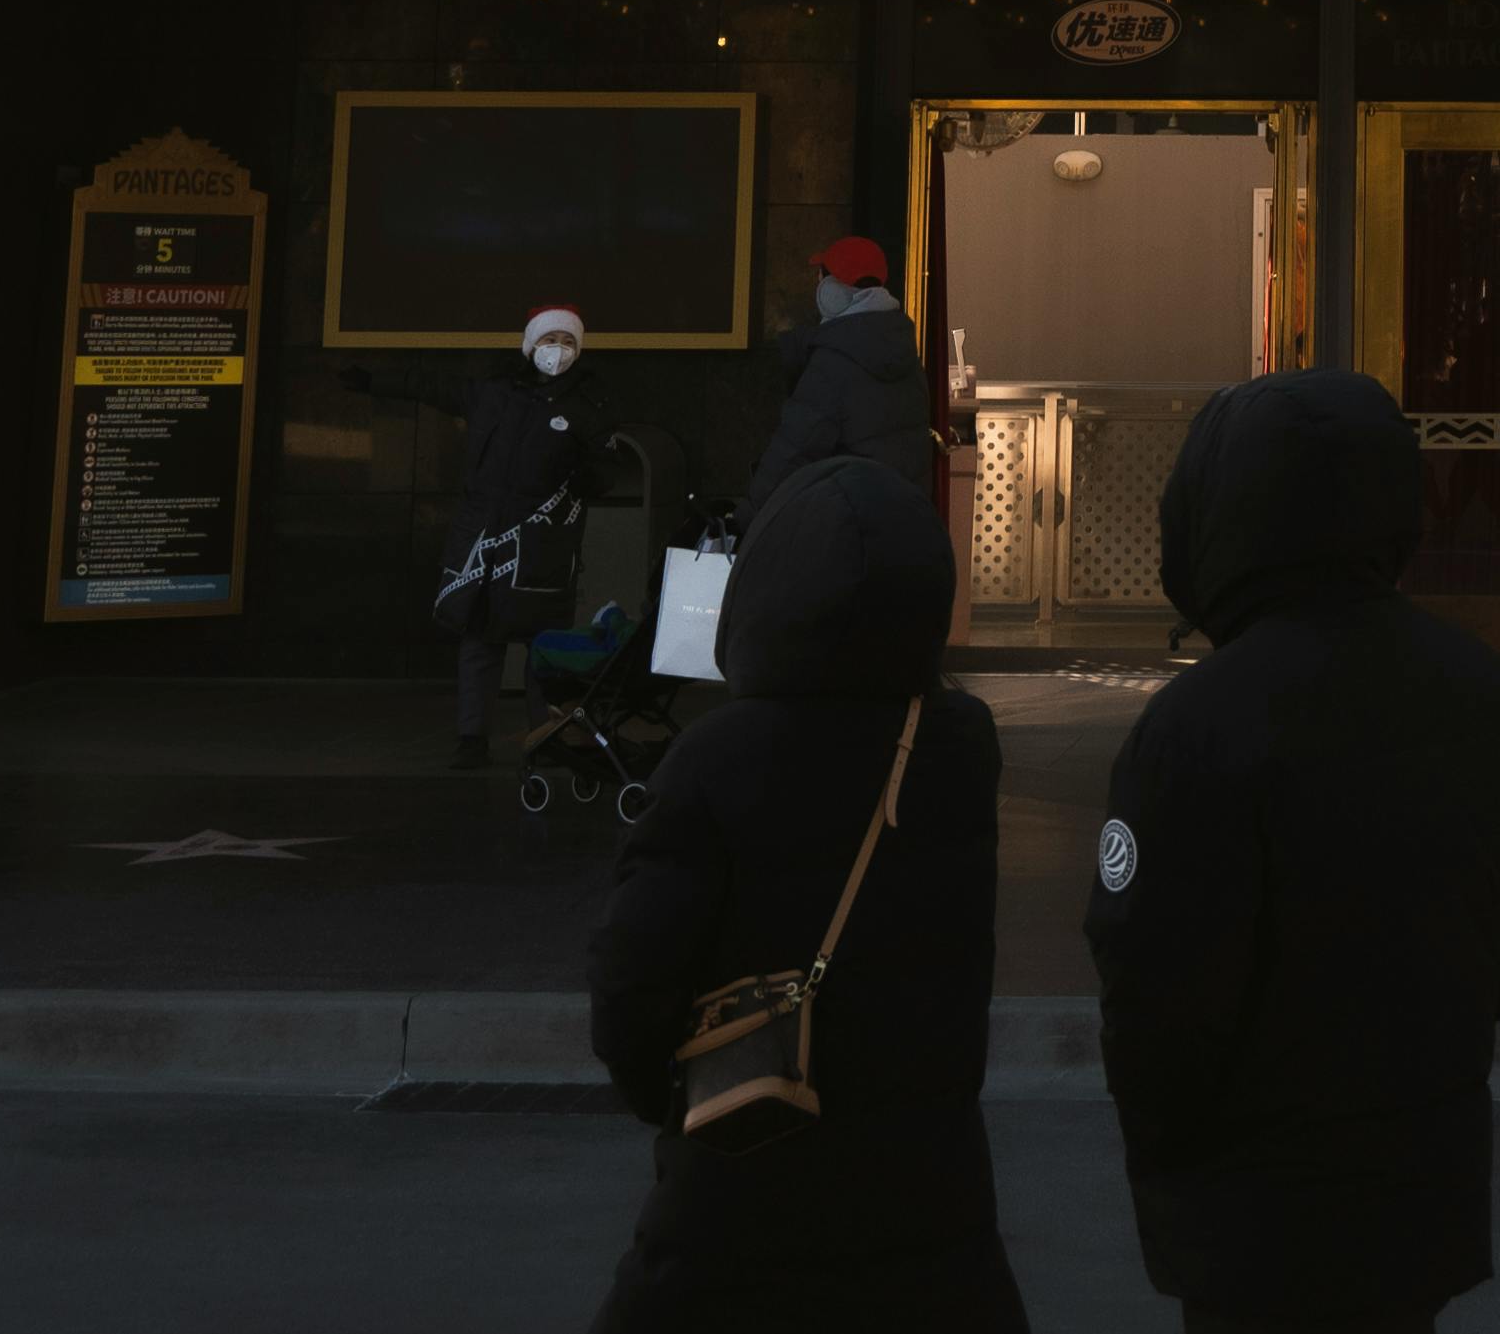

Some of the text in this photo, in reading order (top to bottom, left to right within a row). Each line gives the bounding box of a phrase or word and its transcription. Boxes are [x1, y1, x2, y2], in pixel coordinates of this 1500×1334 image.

[1066, 11, 1168, 47] 优速通
[1109, 44, 1146, 58] EXPRESS
[114, 167, 235, 197] PANTAGES
[153, 227, 176, 237] WAIT
[177, 227, 197, 237] TIME
[155, 238, 174, 263] 5
[154, 265, 192, 275] MINUTES
[145, 288, 225, 305] CAUTION!
